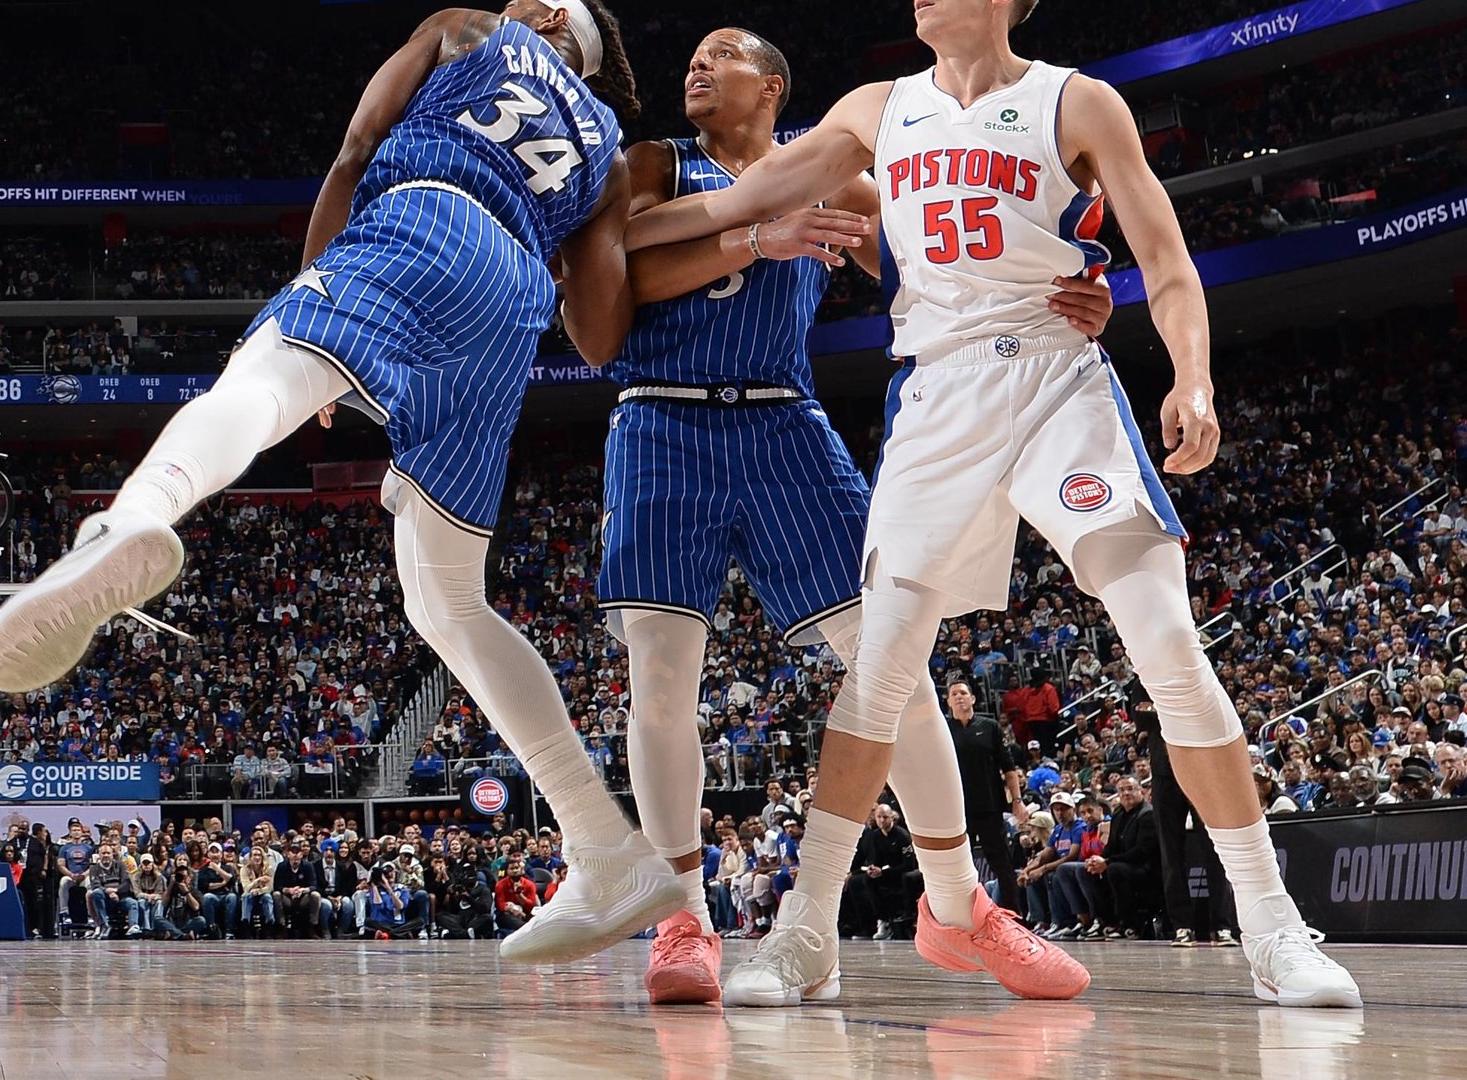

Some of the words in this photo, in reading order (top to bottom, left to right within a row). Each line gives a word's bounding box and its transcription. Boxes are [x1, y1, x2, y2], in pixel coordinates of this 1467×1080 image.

[1231, 11, 1300, 47] xfinity
[983, 122, 1030, 135] StockX
[456, 80, 584, 196] 34
[887, 148, 1042, 203] PISTONS
[34, 188, 60, 202] HIT
[61, 188, 138, 203] DIFFERENT
[141, 189, 186, 203] WHEN
[922, 196, 1004, 265] 55
[1357, 204, 1449, 245] PLAYOFFS
[546, 365, 602, 381] WHEN
[99, 378, 120, 386] DREB
[139, 378, 160, 386] OREB
[187, 378, 197, 386] FT
[102, 388, 116, 401] 24
[147, 388, 154, 401] 8
[1067, 483, 1100, 496] DETROIT
[32, 765, 141, 781] COURTSIDE
[32, 781, 84, 798] CLUB
